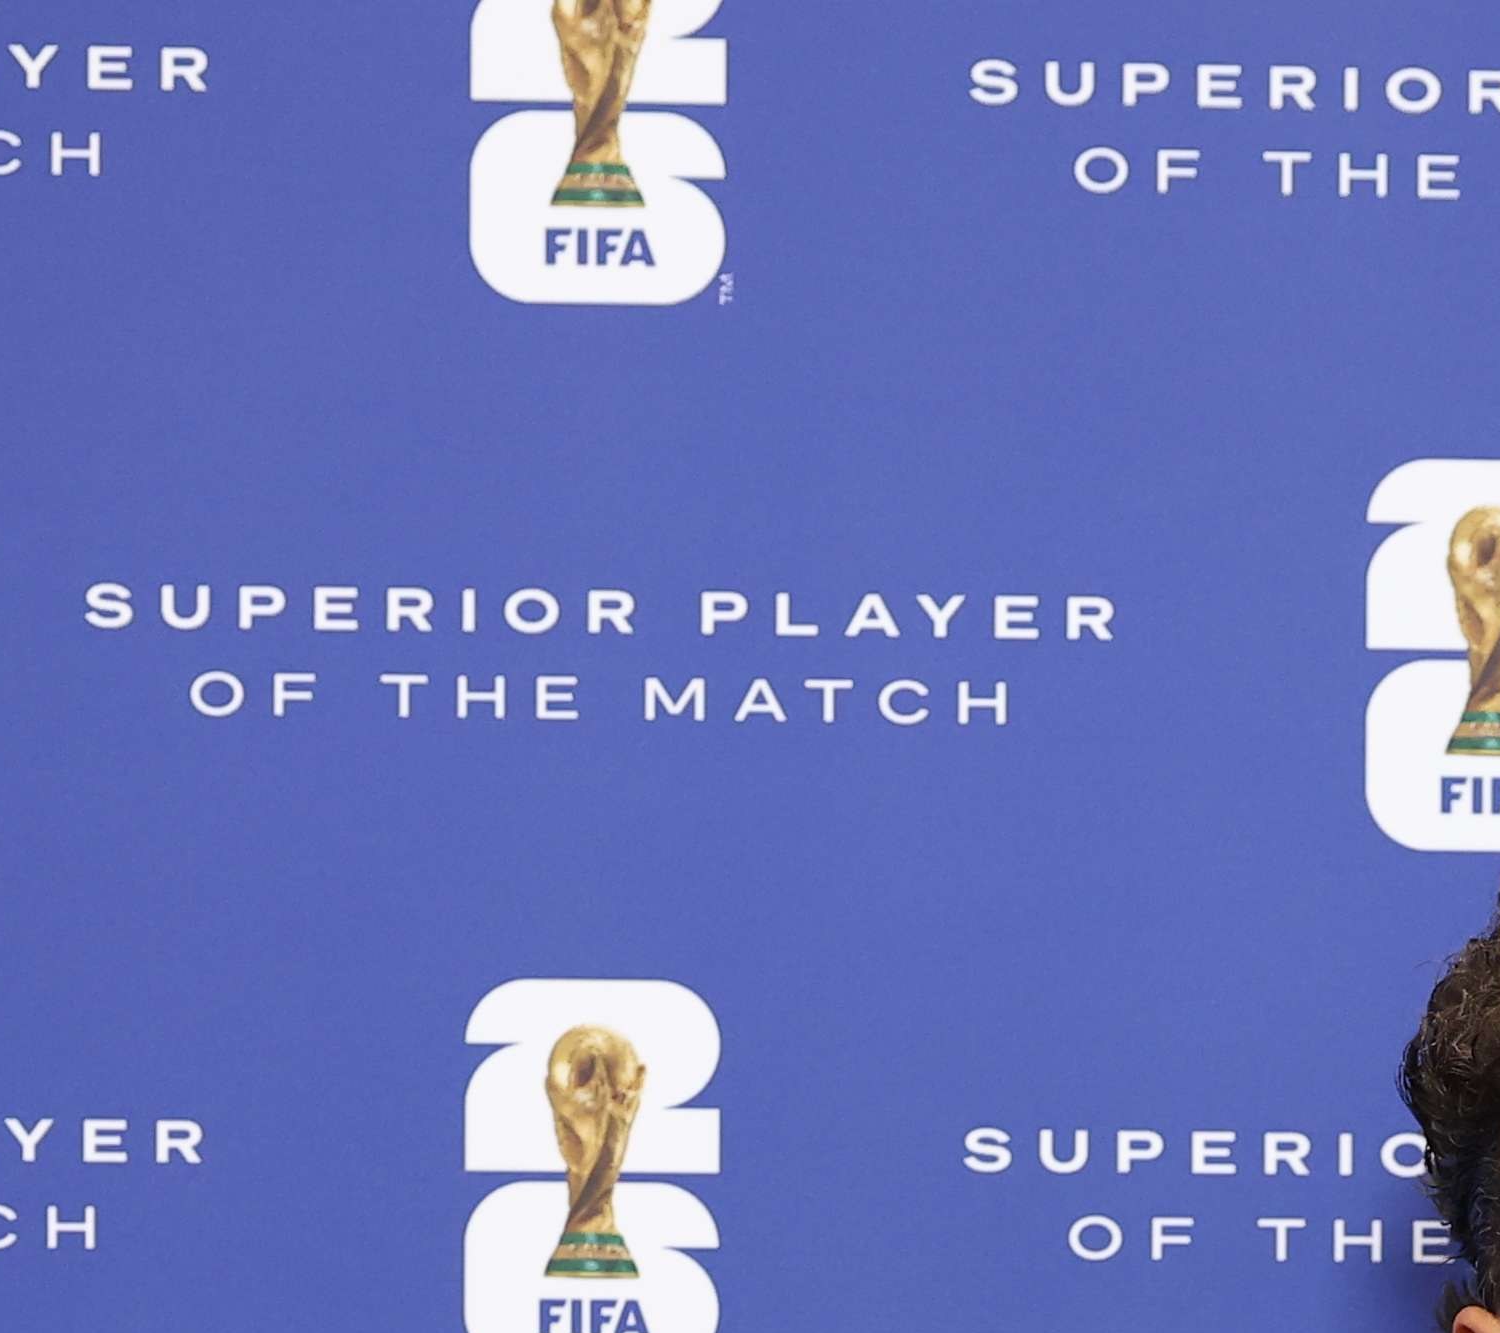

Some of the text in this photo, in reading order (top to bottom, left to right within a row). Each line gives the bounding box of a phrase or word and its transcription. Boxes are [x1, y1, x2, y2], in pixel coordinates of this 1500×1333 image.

[1074, 147, 1201, 194] OF
[1262, 150, 1461, 200] THE
[546, 228, 654, 266] FIFA
[84, 582, 1115, 641] SUPERIOR PLAYER
[189, 670, 1007, 725] OF THE MATCH
[963, 1127, 1429, 1178] SUPERIO
[1068, 1215, 1456, 1264] OF THE
